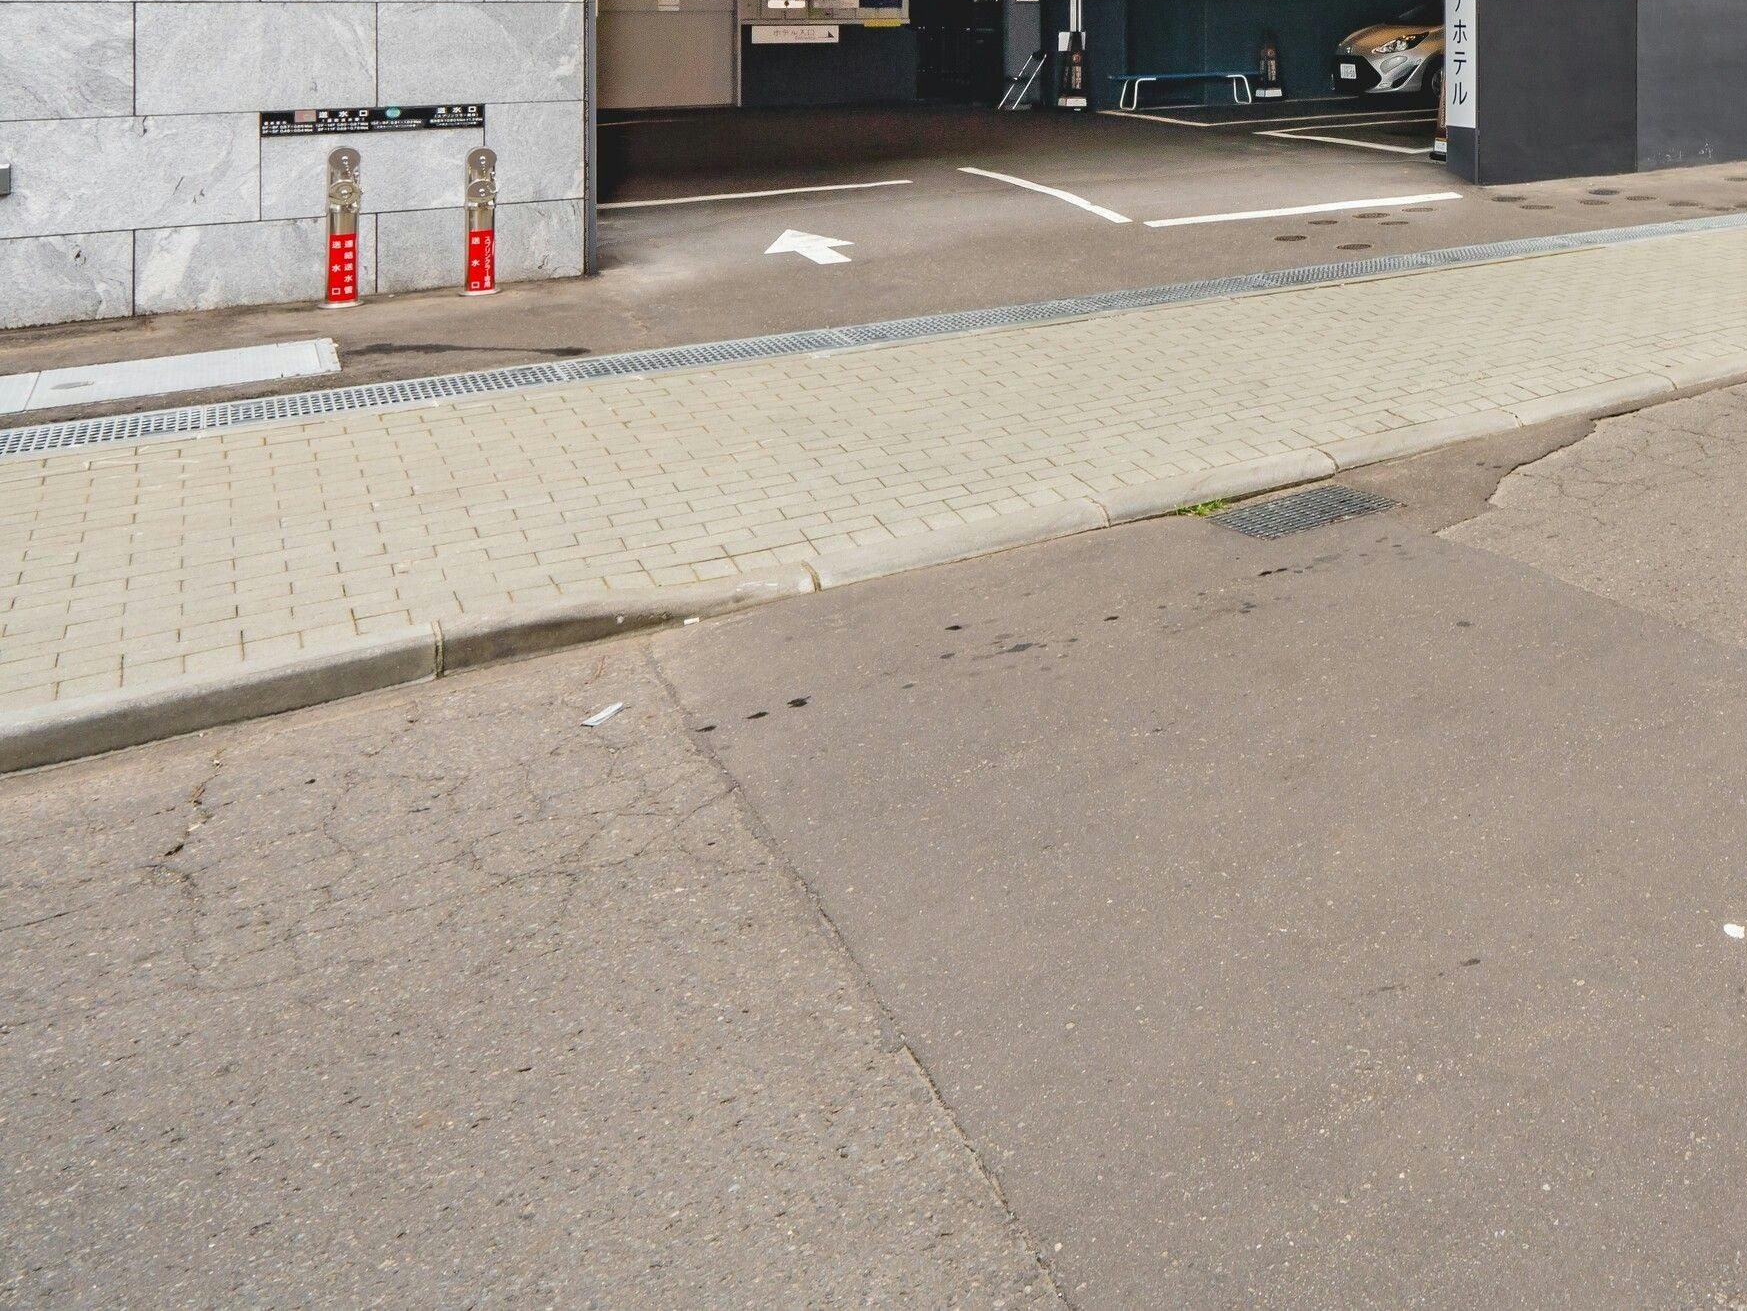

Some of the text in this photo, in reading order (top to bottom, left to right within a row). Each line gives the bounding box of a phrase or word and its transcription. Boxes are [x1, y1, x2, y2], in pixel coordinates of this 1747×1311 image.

[331, 240, 342, 296] 送水口
[471, 236, 481, 290] 送水口
